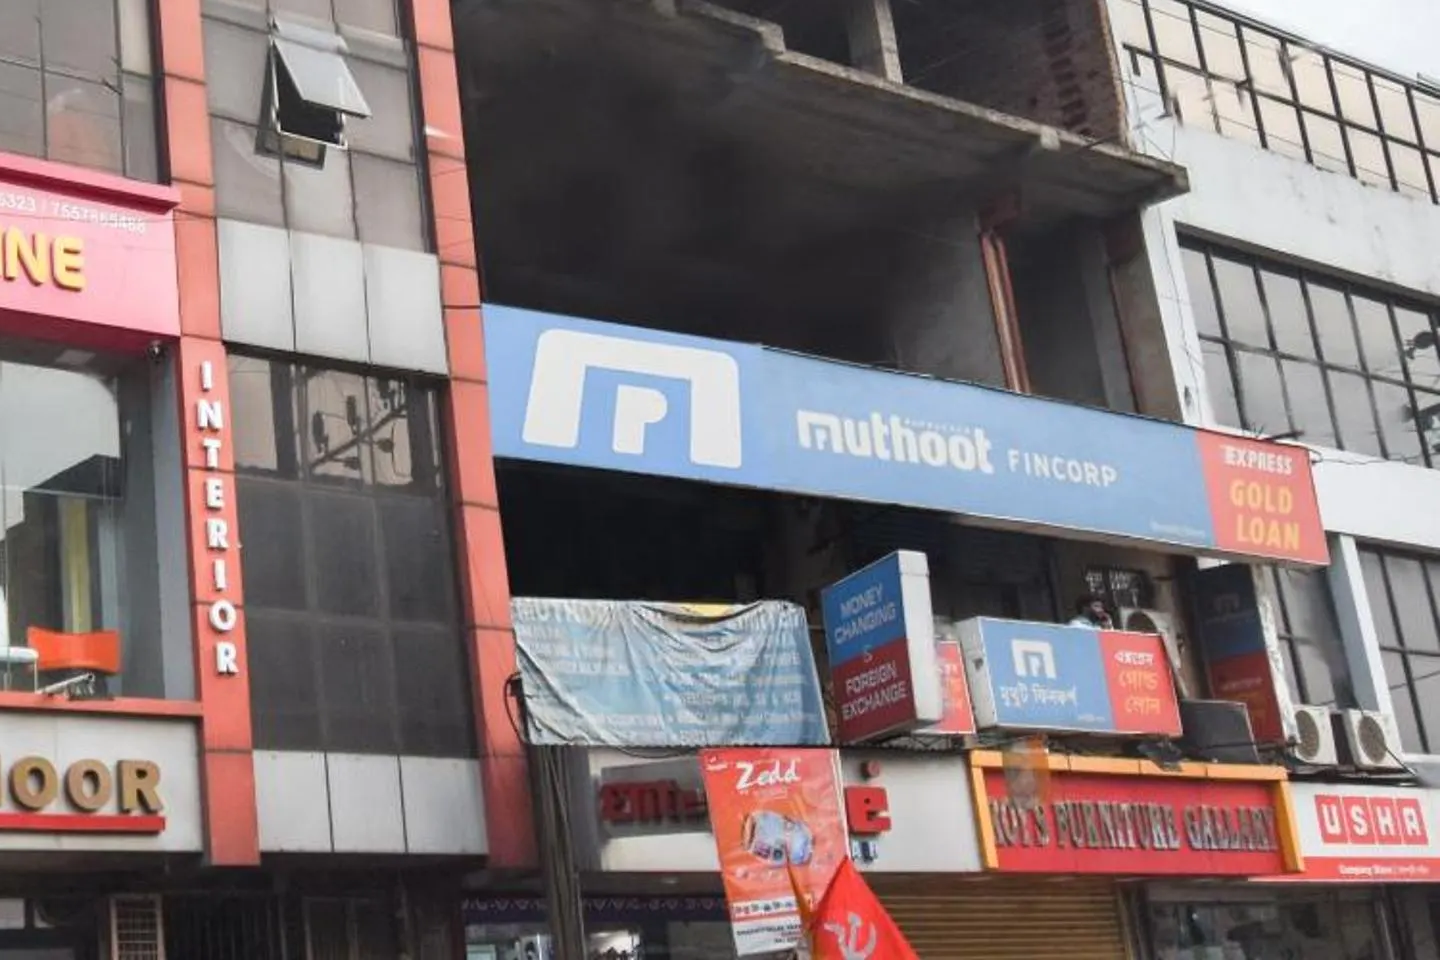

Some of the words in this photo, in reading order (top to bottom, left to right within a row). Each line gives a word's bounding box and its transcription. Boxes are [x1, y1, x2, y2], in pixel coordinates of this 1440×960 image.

[796, 408, 994, 474] muthoot
[1008, 448, 1118, 488] FINCORP
[1222, 443, 1293, 476] EXPRESS
[1229, 478, 1293, 514] GOLD
[197, 359, 239, 676] INTERIOR
[1235, 514, 1301, 552] LOAN
[839, 583, 885, 617] MONEY
[834, 600, 897, 646] CHANGING
[845, 659, 898, 695] FOREIGN
[840, 680, 909, 721] EXCHANGE
[1320, 802, 1423, 838] USHA
